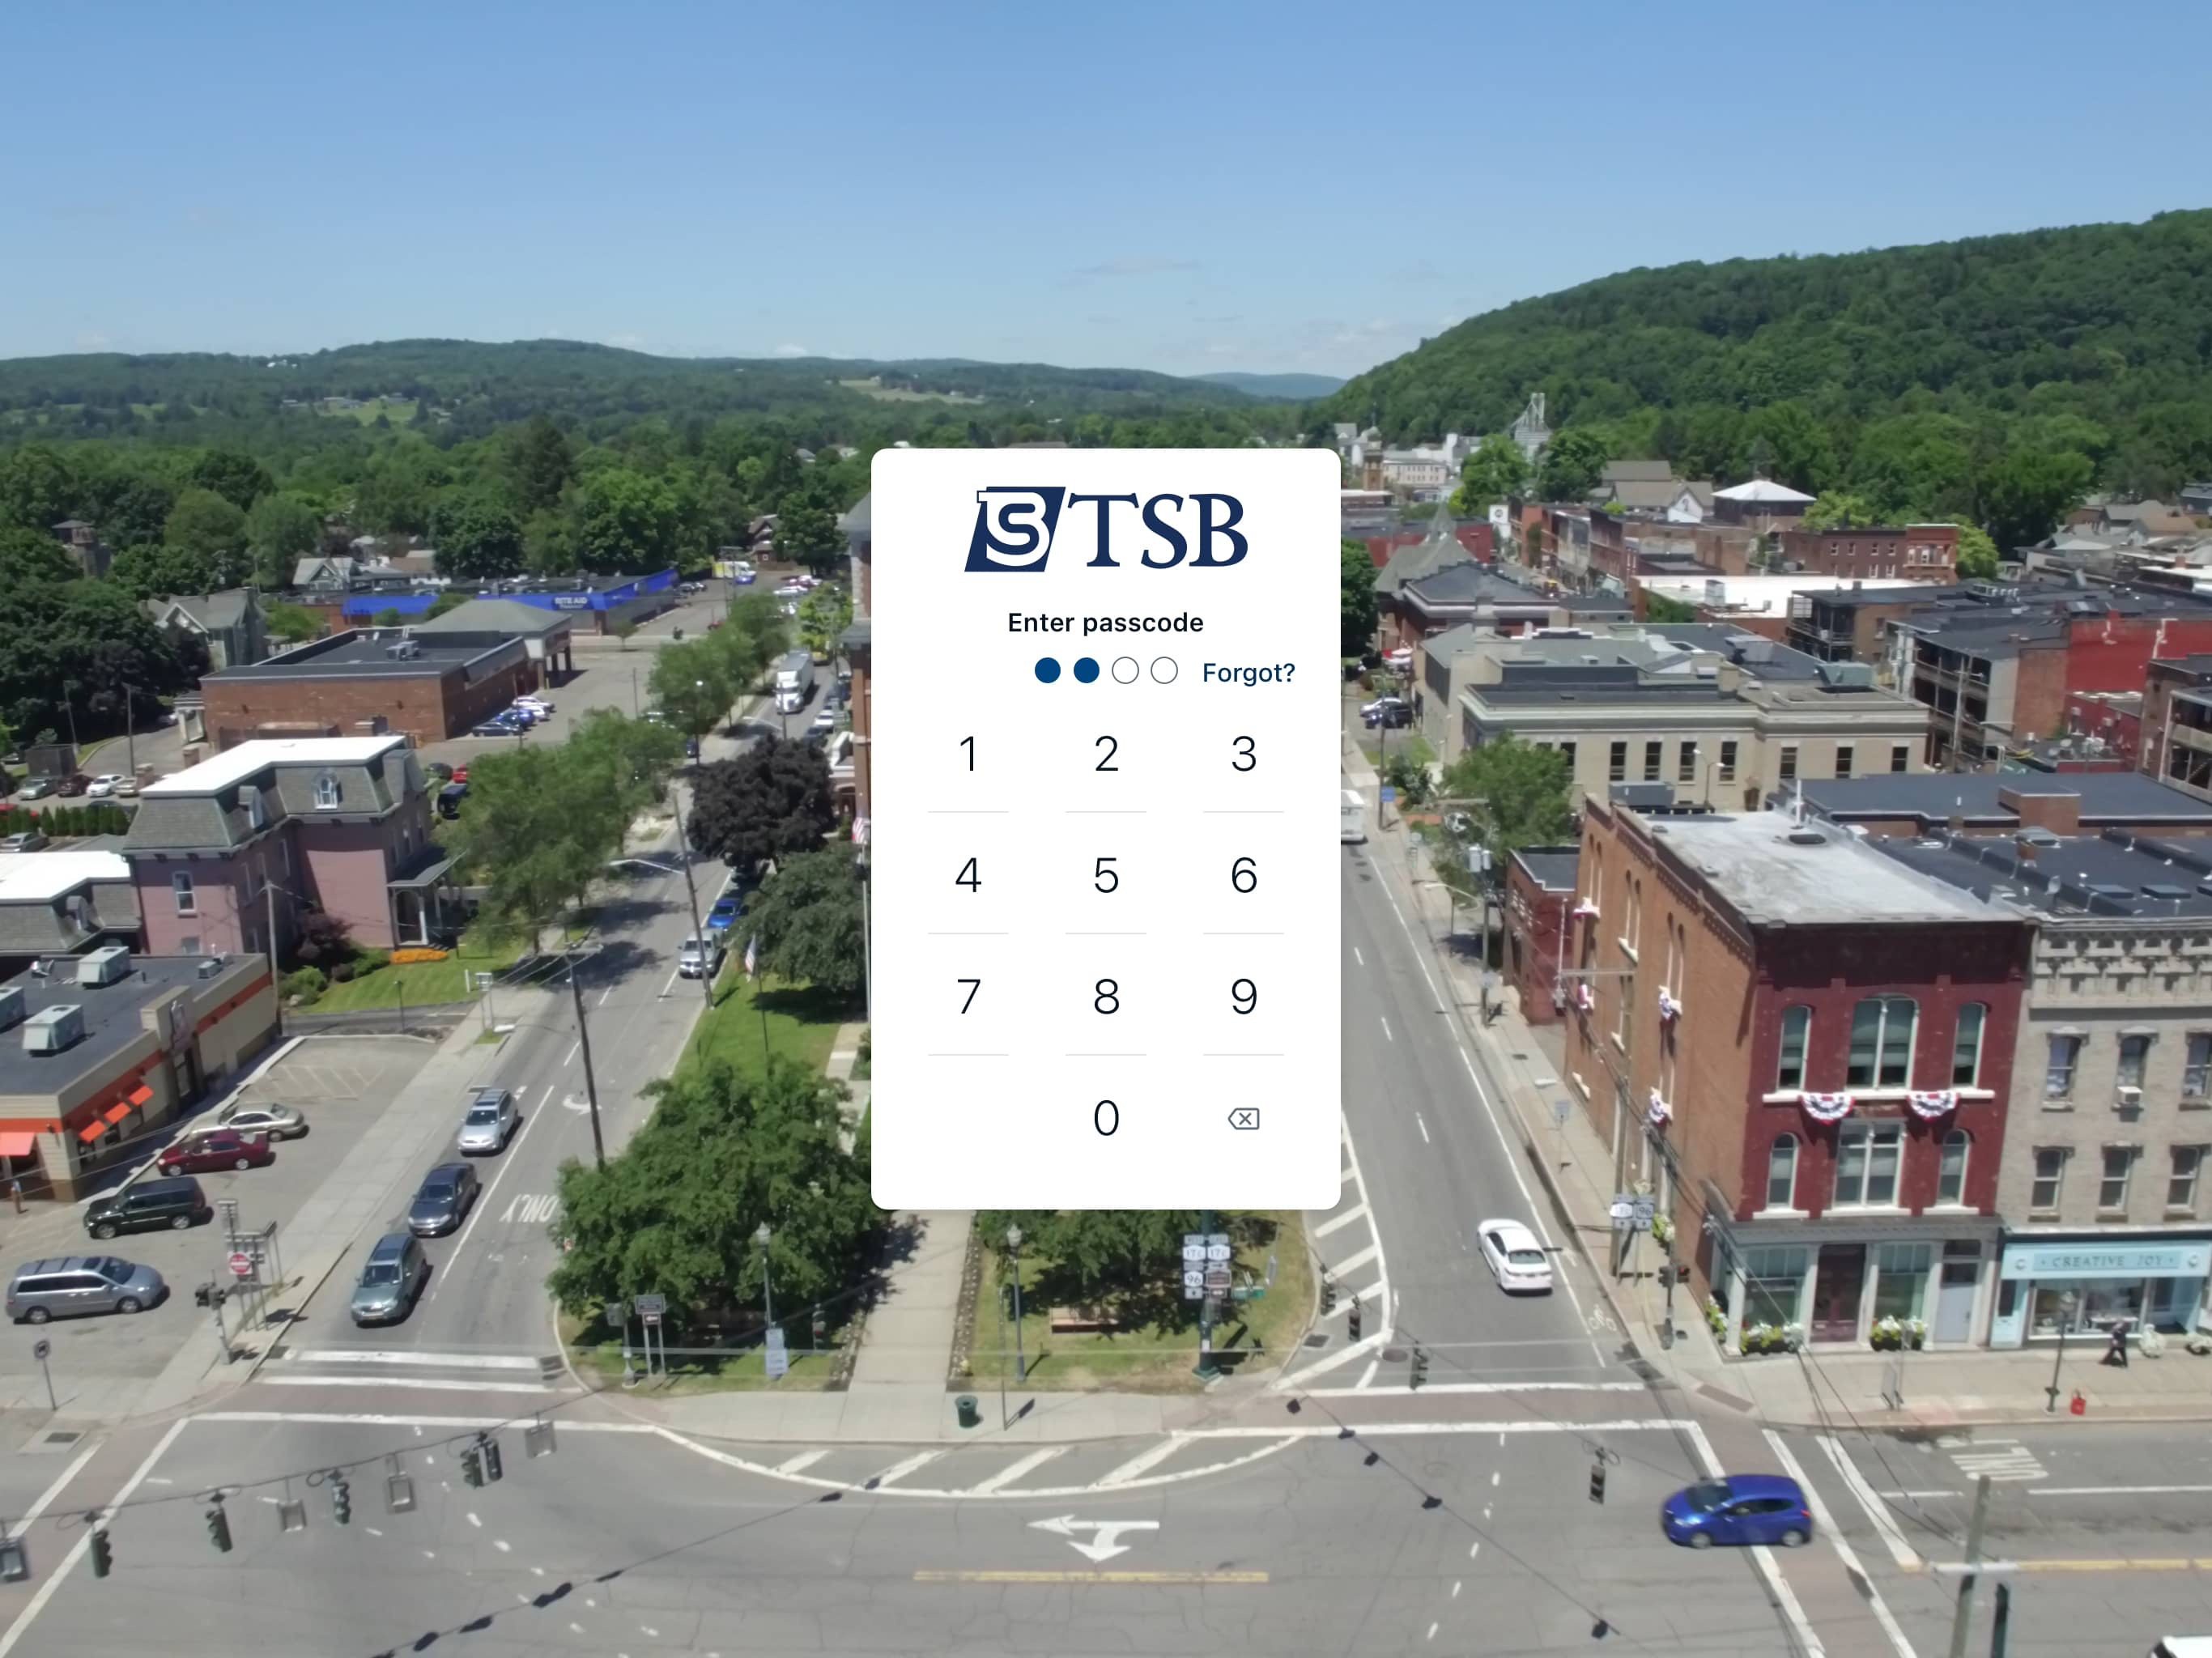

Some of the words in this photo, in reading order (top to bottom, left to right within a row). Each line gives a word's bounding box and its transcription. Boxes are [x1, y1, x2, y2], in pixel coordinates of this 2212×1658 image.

[2052, 1255, 2126, 1268] CREATIVE
[2137, 1254, 2164, 1266] JOY
[1187, 1274, 1202, 1286] 96
